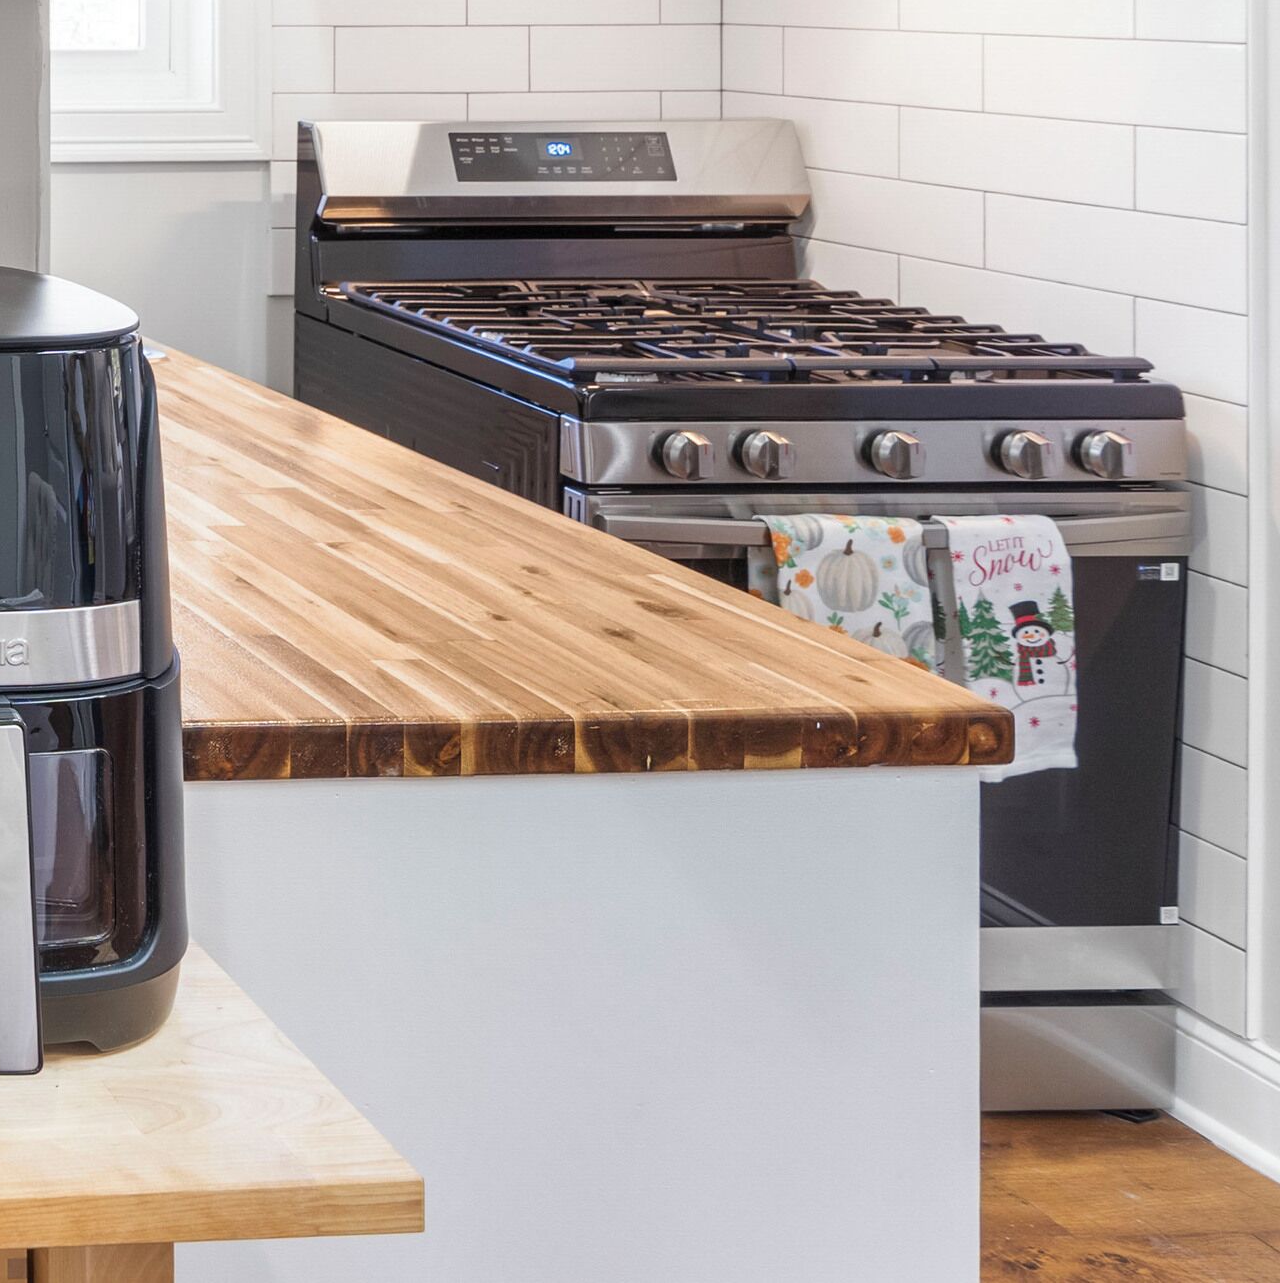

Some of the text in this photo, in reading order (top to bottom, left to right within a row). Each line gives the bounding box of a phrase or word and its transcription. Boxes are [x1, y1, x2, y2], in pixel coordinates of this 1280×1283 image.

[988, 536, 1024, 552] LET IT
[968, 539, 1053, 587] Snow
